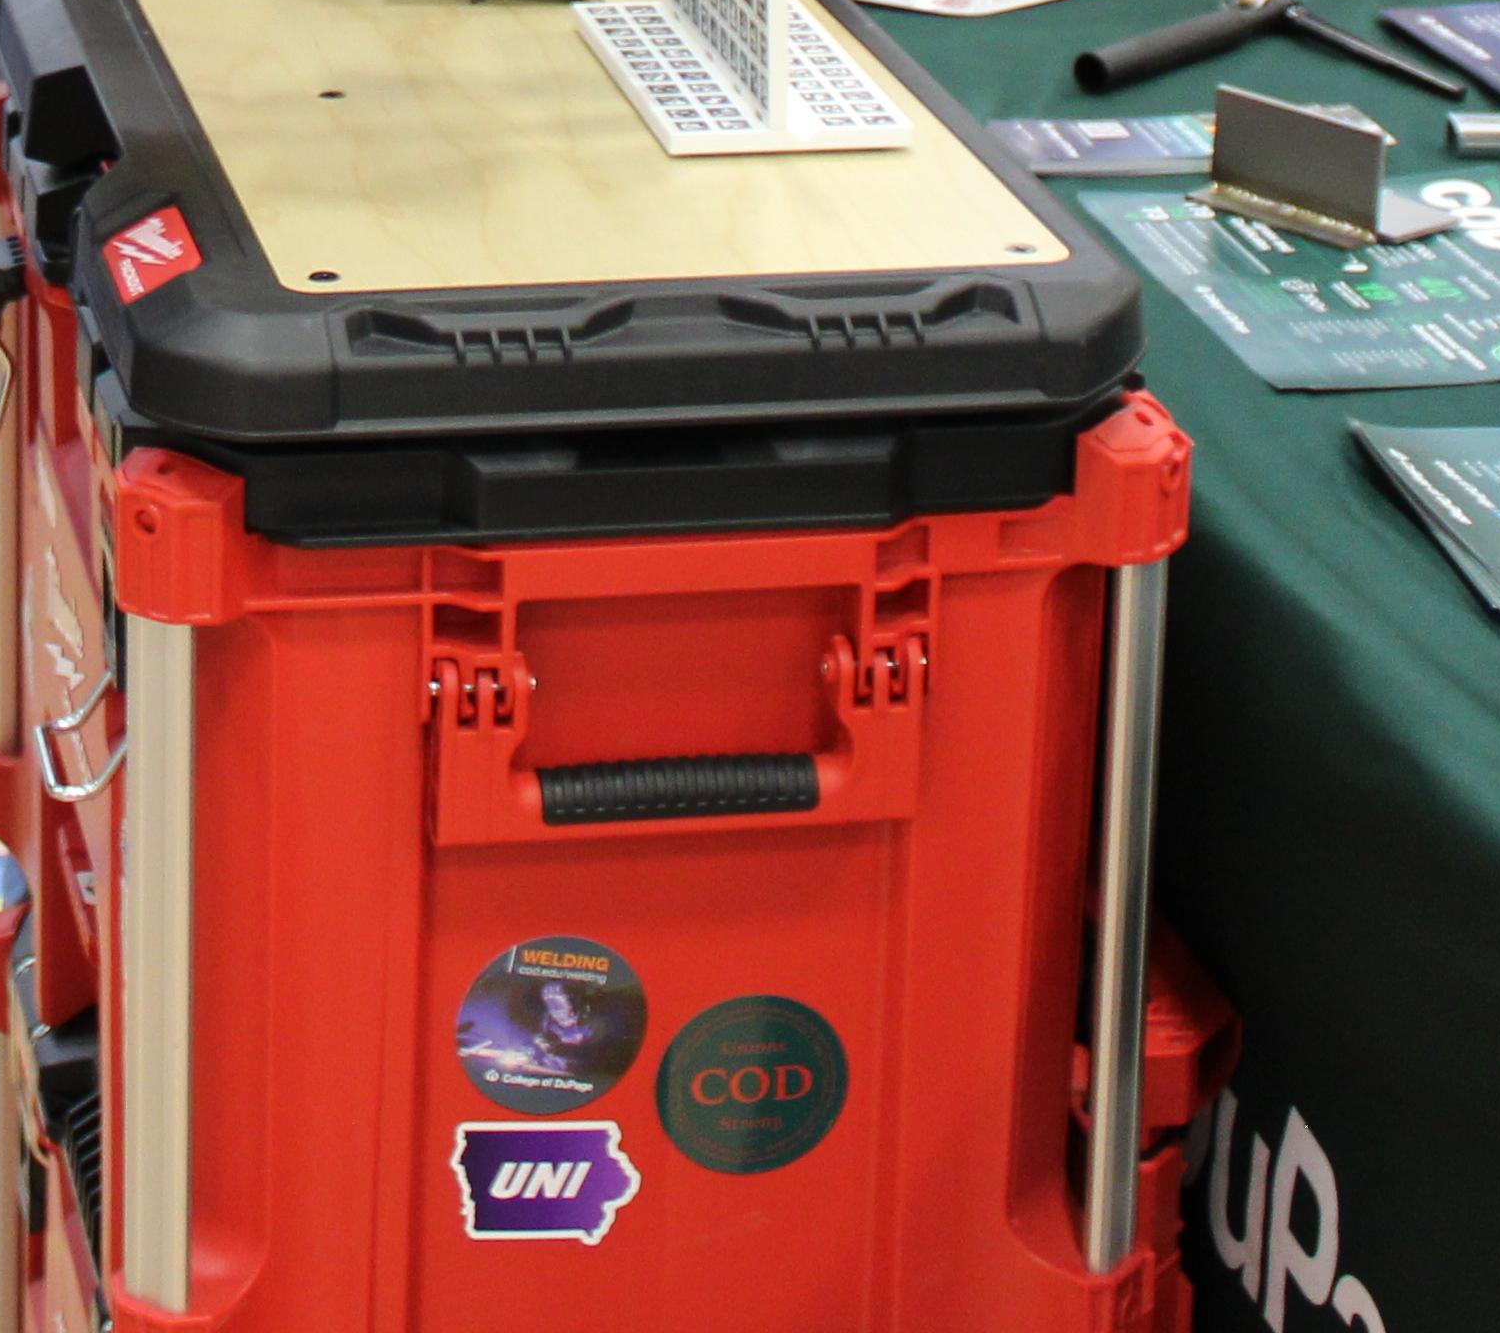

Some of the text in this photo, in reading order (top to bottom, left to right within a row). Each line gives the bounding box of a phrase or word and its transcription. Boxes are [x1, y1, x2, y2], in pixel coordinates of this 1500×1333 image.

[521, 948, 611, 973] WELDING
[503, 1072, 594, 1093] College of DuPage
[690, 1063, 814, 1107] COD
[489, 1161, 592, 1200] UNI
